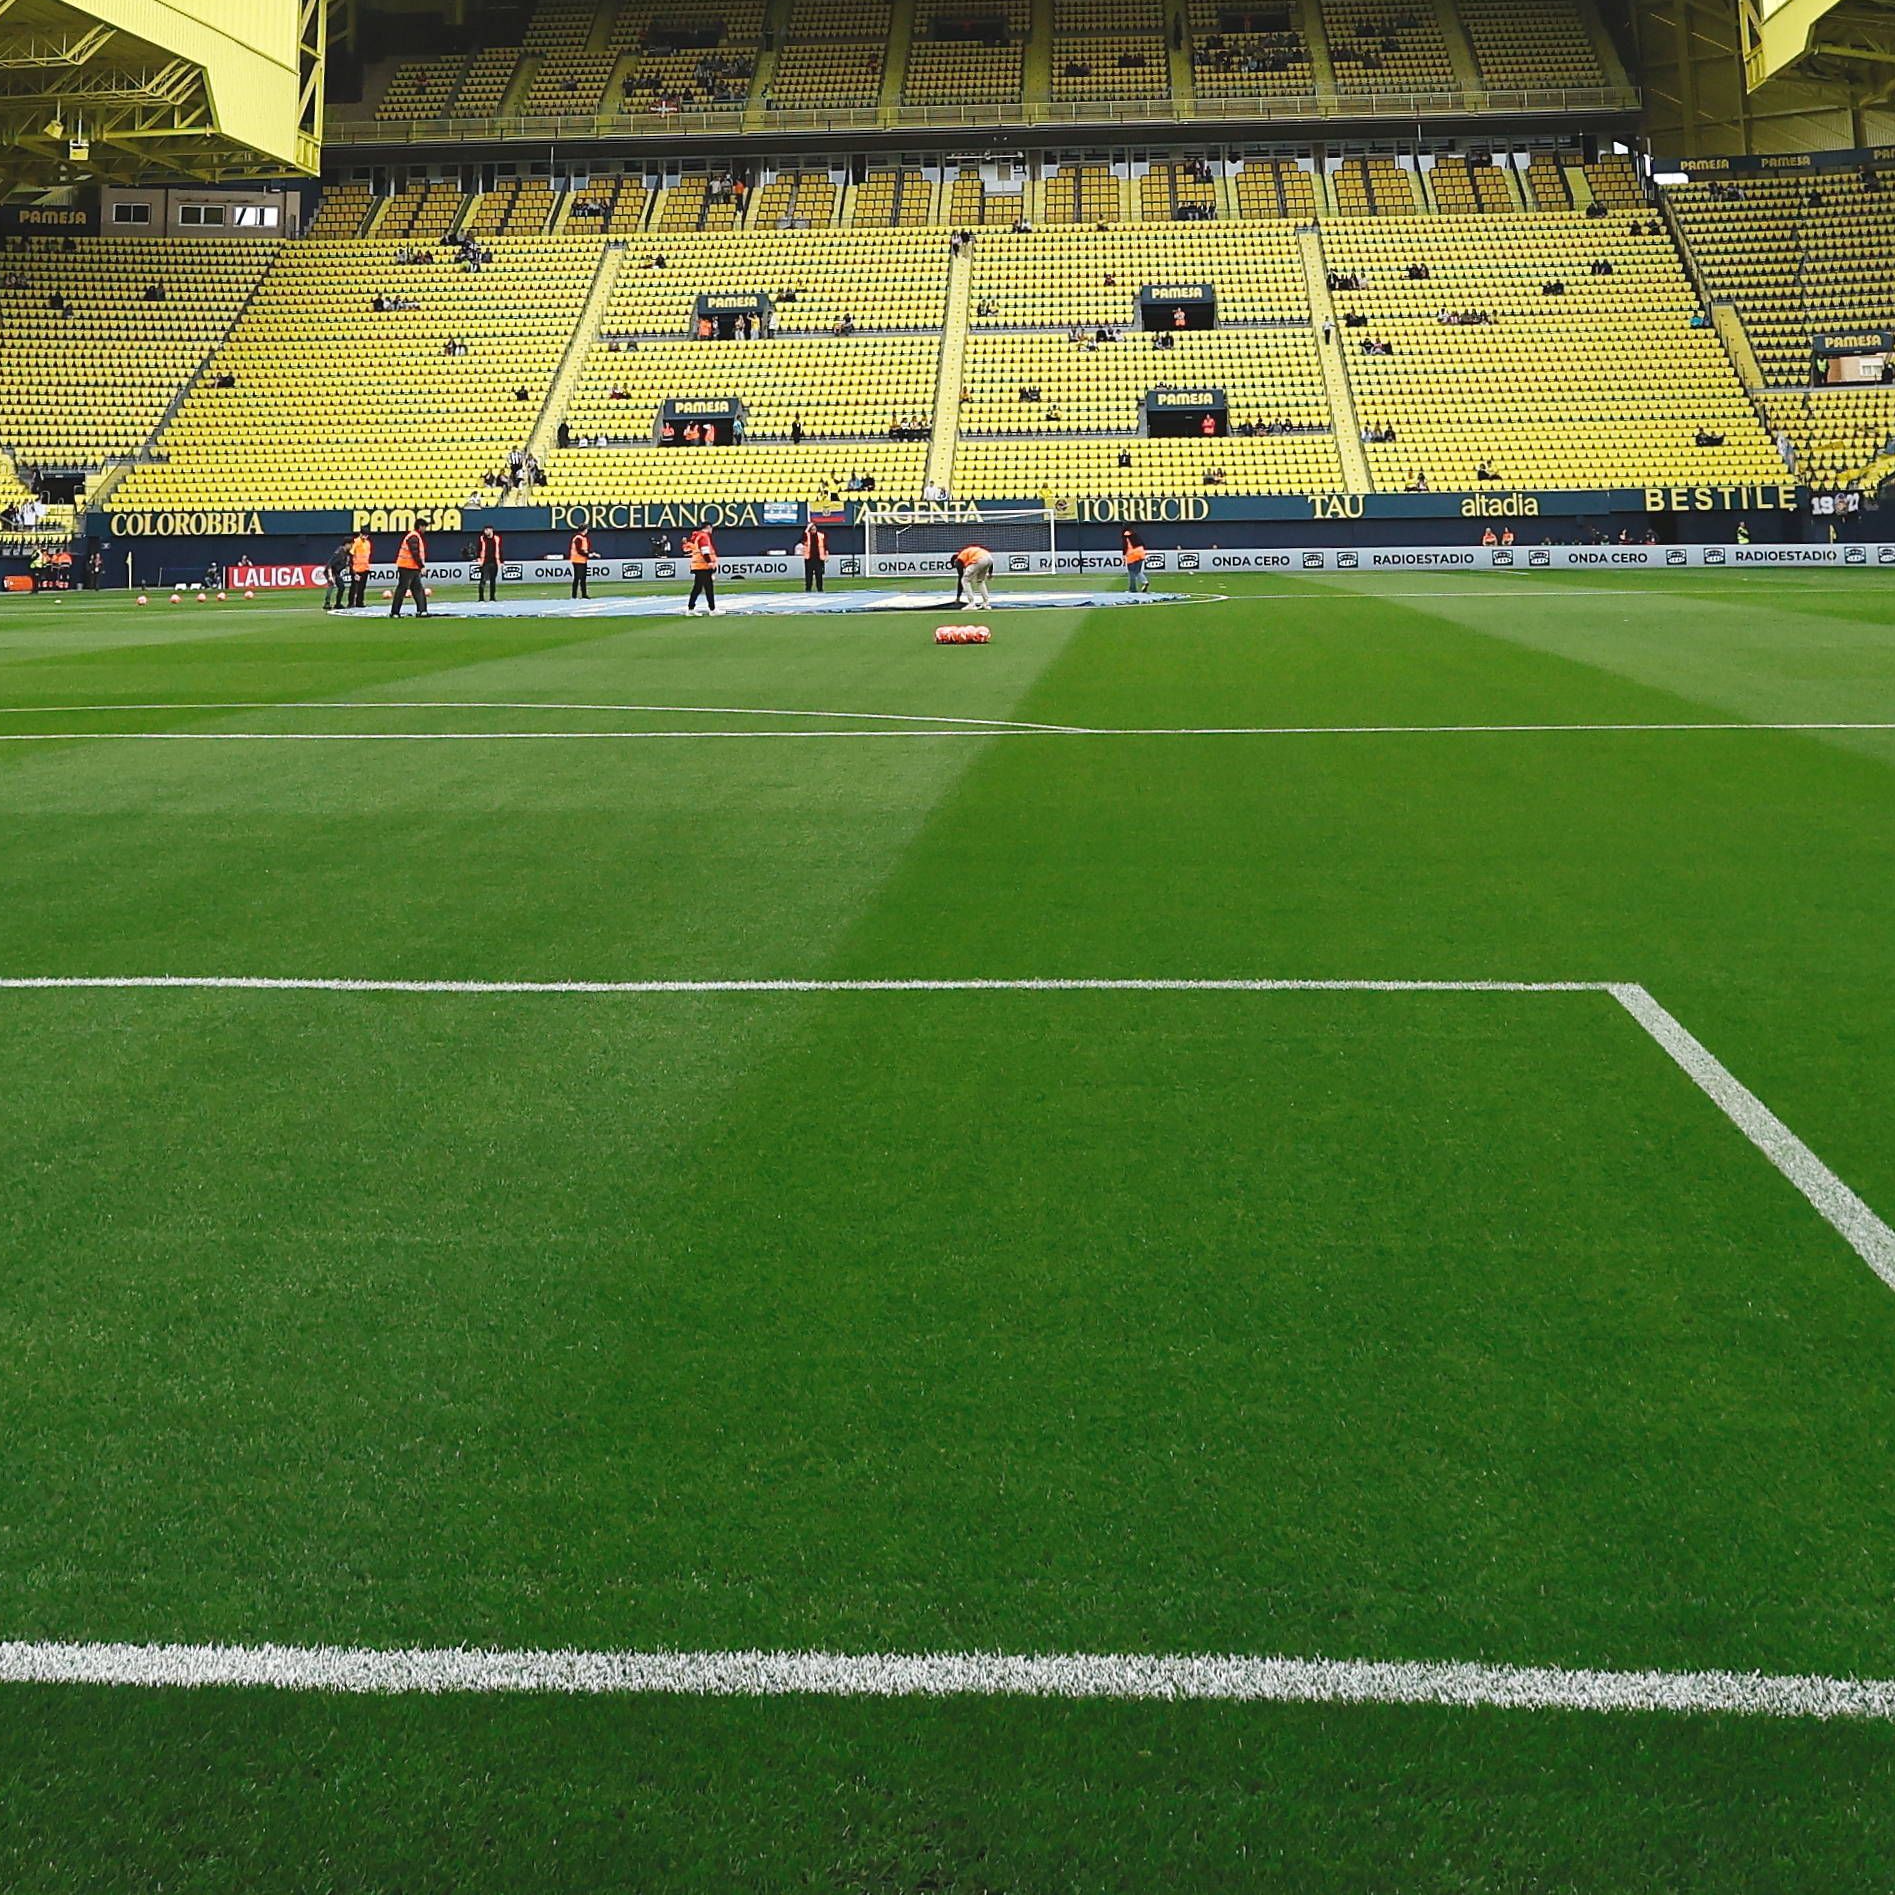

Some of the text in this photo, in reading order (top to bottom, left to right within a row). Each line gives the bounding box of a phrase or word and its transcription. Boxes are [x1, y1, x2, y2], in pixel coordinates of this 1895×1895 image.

[1680, 159, 1730, 171] PAMESA
[1760, 156, 1811, 169] PAMESA
[19, 210, 87, 224] PAMESA
[1152, 287, 1202, 299] PAMESA
[707, 296, 758, 308] PAMESA
[1824, 334, 1881, 349] PAMESA
[1157, 393, 1213, 405] PAMESA
[675, 401, 730, 413] PAMESA
[1461, 491, 1539, 518] altadia
[1645, 485, 1798, 512] BESTILE
[855, 500, 984, 524] ARGENTA
[1078, 497, 1209, 522] TORRECID
[1307, 495, 1365, 519] TAU
[352, 508, 463, 532] PAMESA
[551, 503, 759, 530] PORCELANOSA
[110, 511, 265, 536] COLOROBBIA
[1212, 556, 1290, 567] ONDA CERO
[1373, 553, 1474, 565] RADIOESTADIO
[1568, 552, 1648, 563] ONDA CERO
[1735, 550, 1837, 562] RADIOESTADIO
[713, 563, 788, 574] IOESTADIO
[879, 561, 916, 572] ONDA
[1040, 557, 1128, 568] RADIOESTAD
[233, 567, 306, 587] LALIGA
[370, 568, 462, 580] RADITADIO
[535, 566, 610, 577] ONDA ERO
